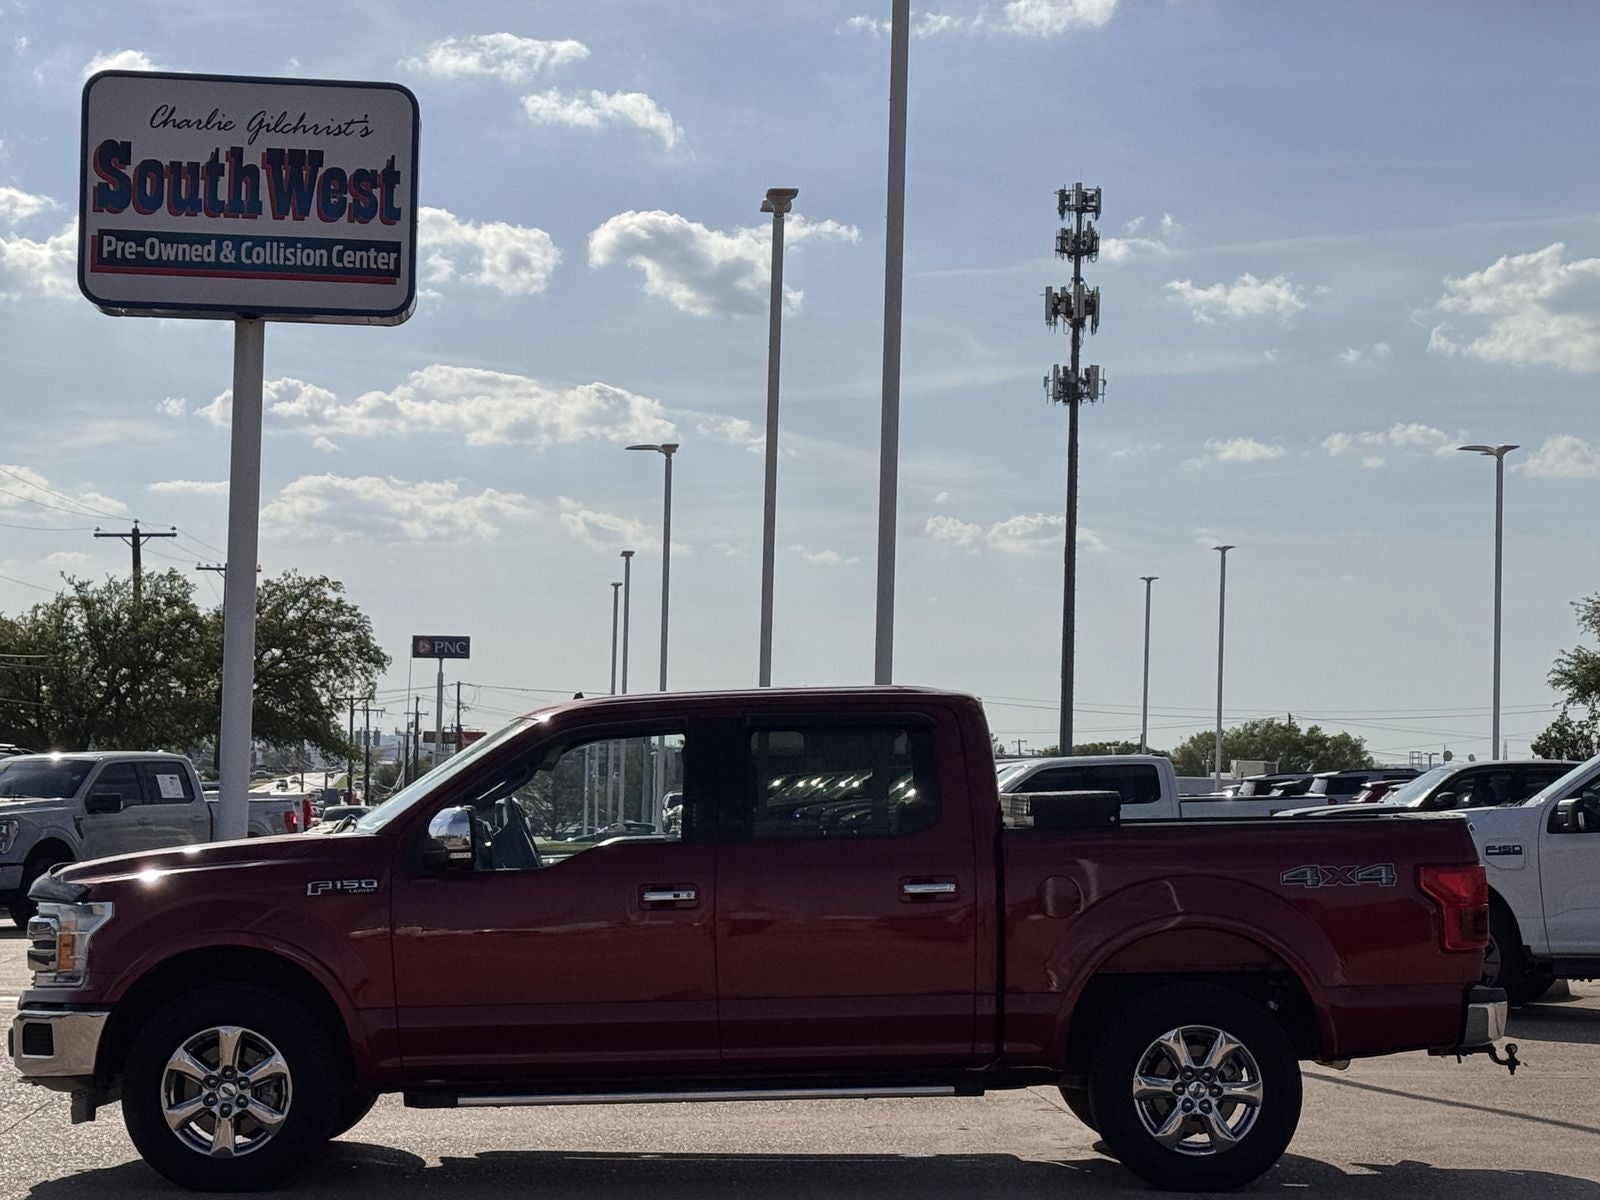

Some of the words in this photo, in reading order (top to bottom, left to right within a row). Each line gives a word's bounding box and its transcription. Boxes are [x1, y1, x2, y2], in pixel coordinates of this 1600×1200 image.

[150, 104, 236, 131] Charlie
[246, 110, 375, 145] Gilchrist's
[93, 139, 402, 225] SouthWest
[102, 235, 216, 262] Pre-Owned
[219, 240, 236, 264] &
[240, 241, 328, 267] Collision
[331, 244, 398, 270] Center
[434, 640, 467, 654] PNC
